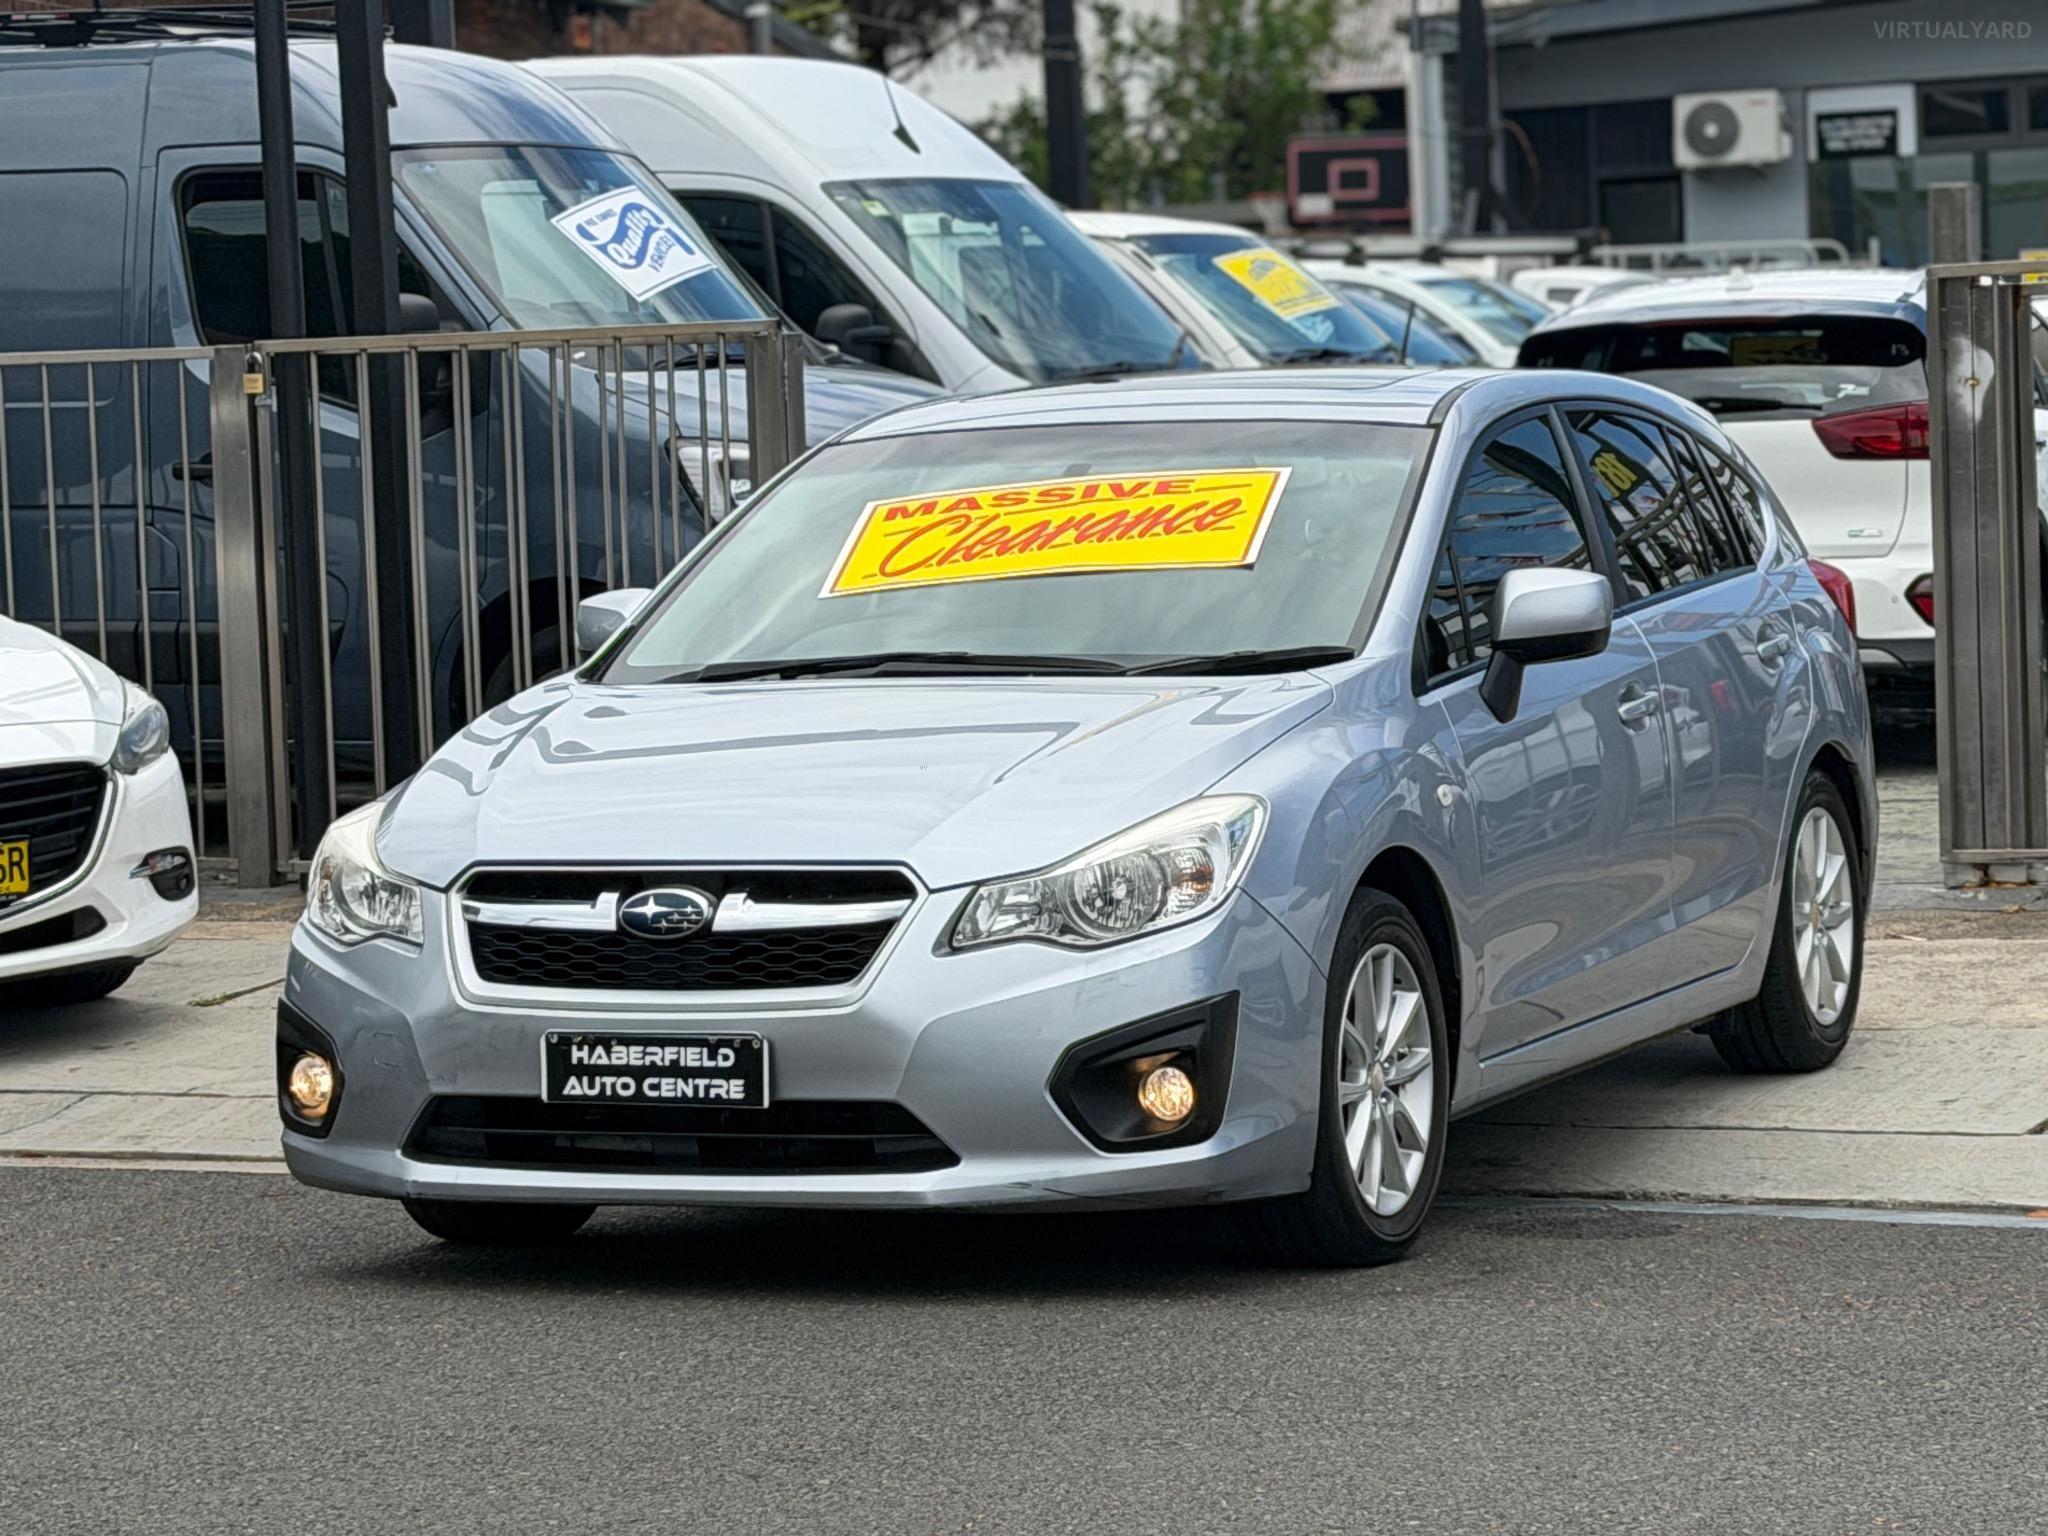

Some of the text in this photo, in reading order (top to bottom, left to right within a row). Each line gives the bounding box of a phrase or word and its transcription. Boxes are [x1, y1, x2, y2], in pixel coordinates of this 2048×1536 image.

[607, 208, 664, 267] Quality
[882, 479, 1196, 522] MASSIVE
[878, 496, 1244, 578] Clearance
[571, 1044, 736, 1068] HABERFIELD
[562, 1075, 746, 1100] AUTO CENTRE
